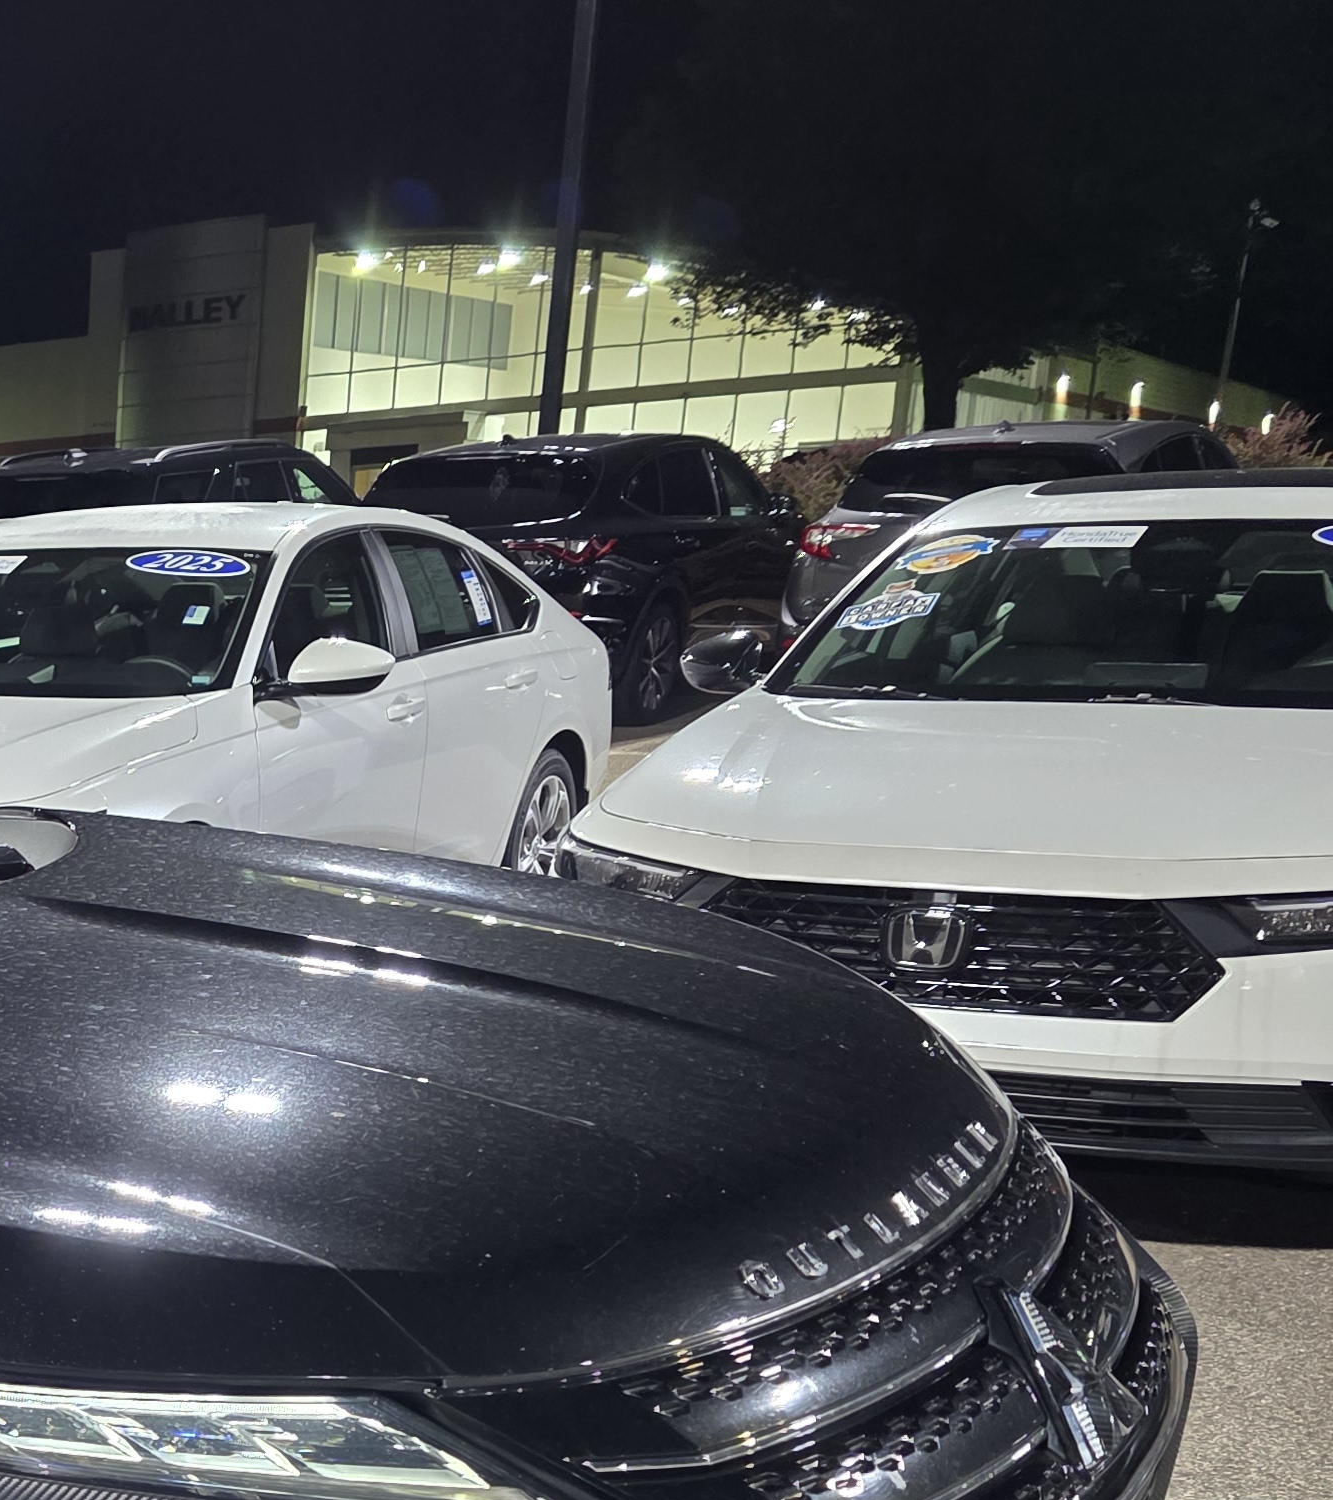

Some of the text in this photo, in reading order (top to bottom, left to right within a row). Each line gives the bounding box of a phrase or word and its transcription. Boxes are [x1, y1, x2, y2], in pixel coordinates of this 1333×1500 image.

[128, 293, 247, 333] NALLEY
[143, 553, 234, 572] 2025
[849, 597, 931, 615] CARFAX
[858, 605, 926, 621] OWNER
[737, 1120, 999, 1300] OUTLANDER
